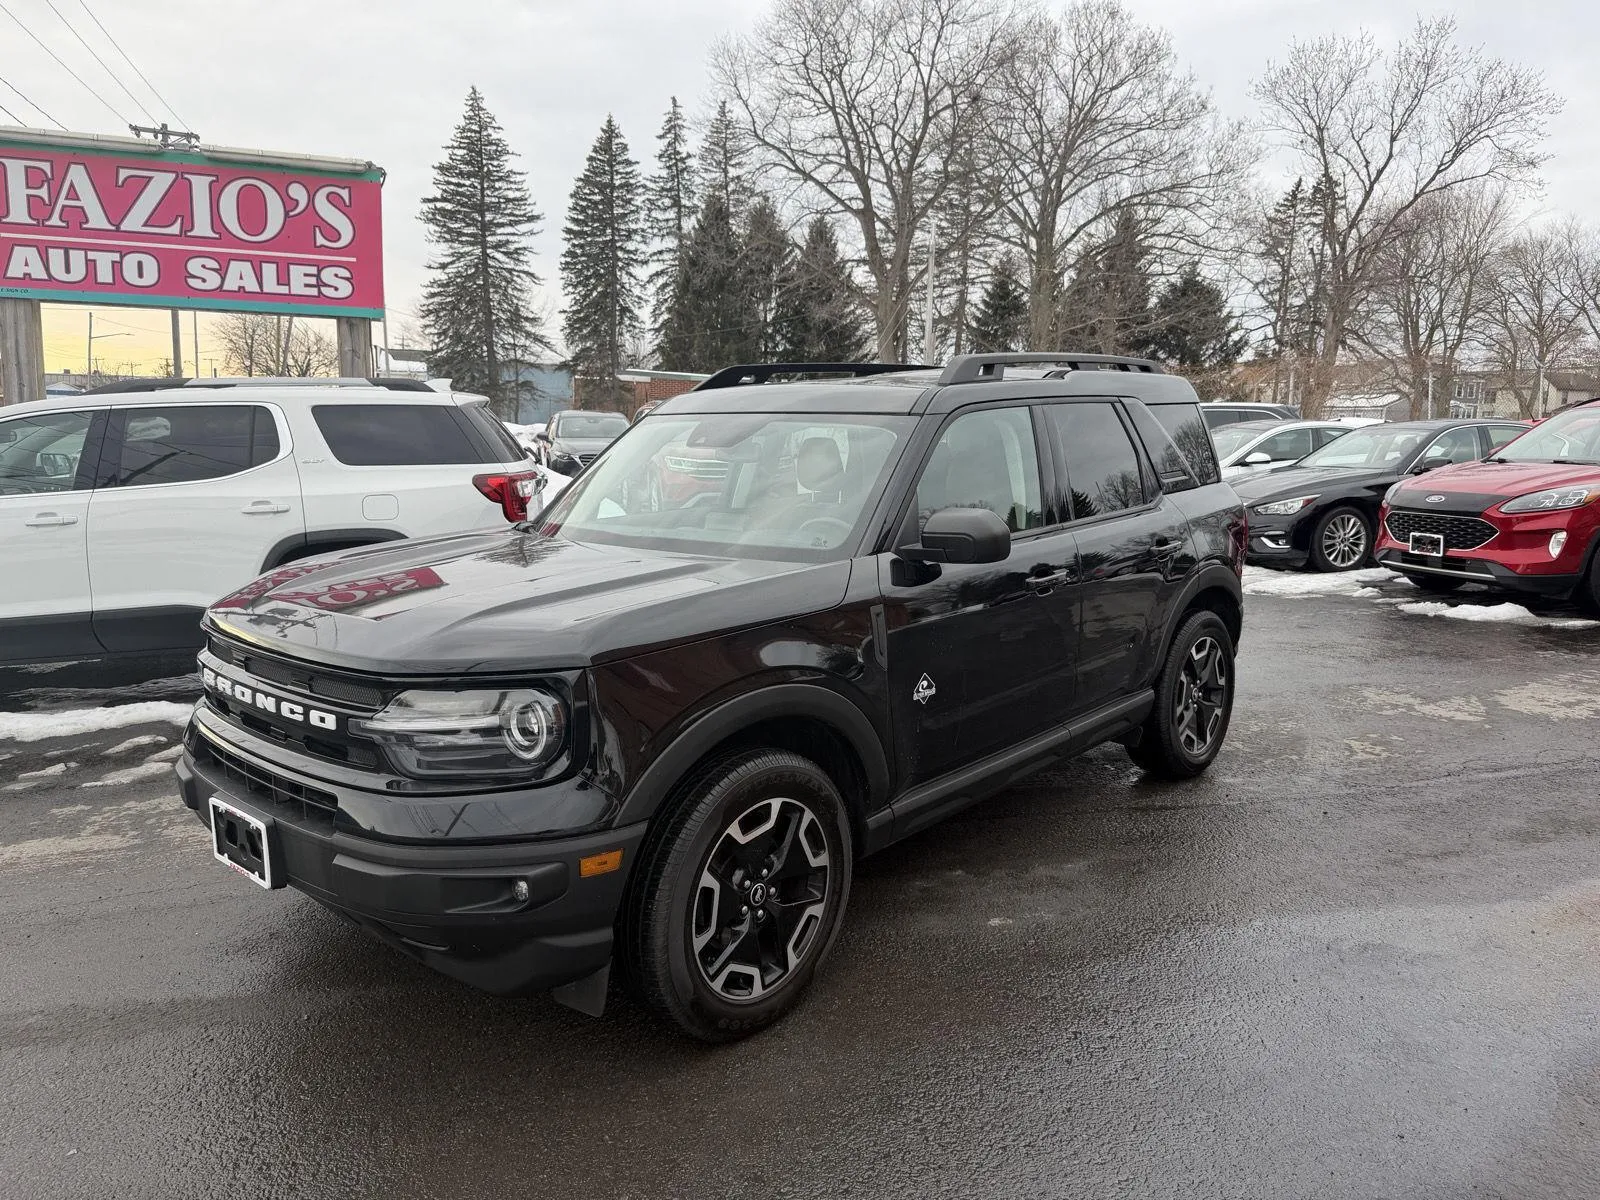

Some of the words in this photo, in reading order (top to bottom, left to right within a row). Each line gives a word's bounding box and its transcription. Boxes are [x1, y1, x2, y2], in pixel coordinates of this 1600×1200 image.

[0, 156, 356, 249] FAZIO'S
[4, 243, 161, 288] AUTO
[186, 256, 355, 299] SALES
[203, 667, 337, 731] BRONCO
